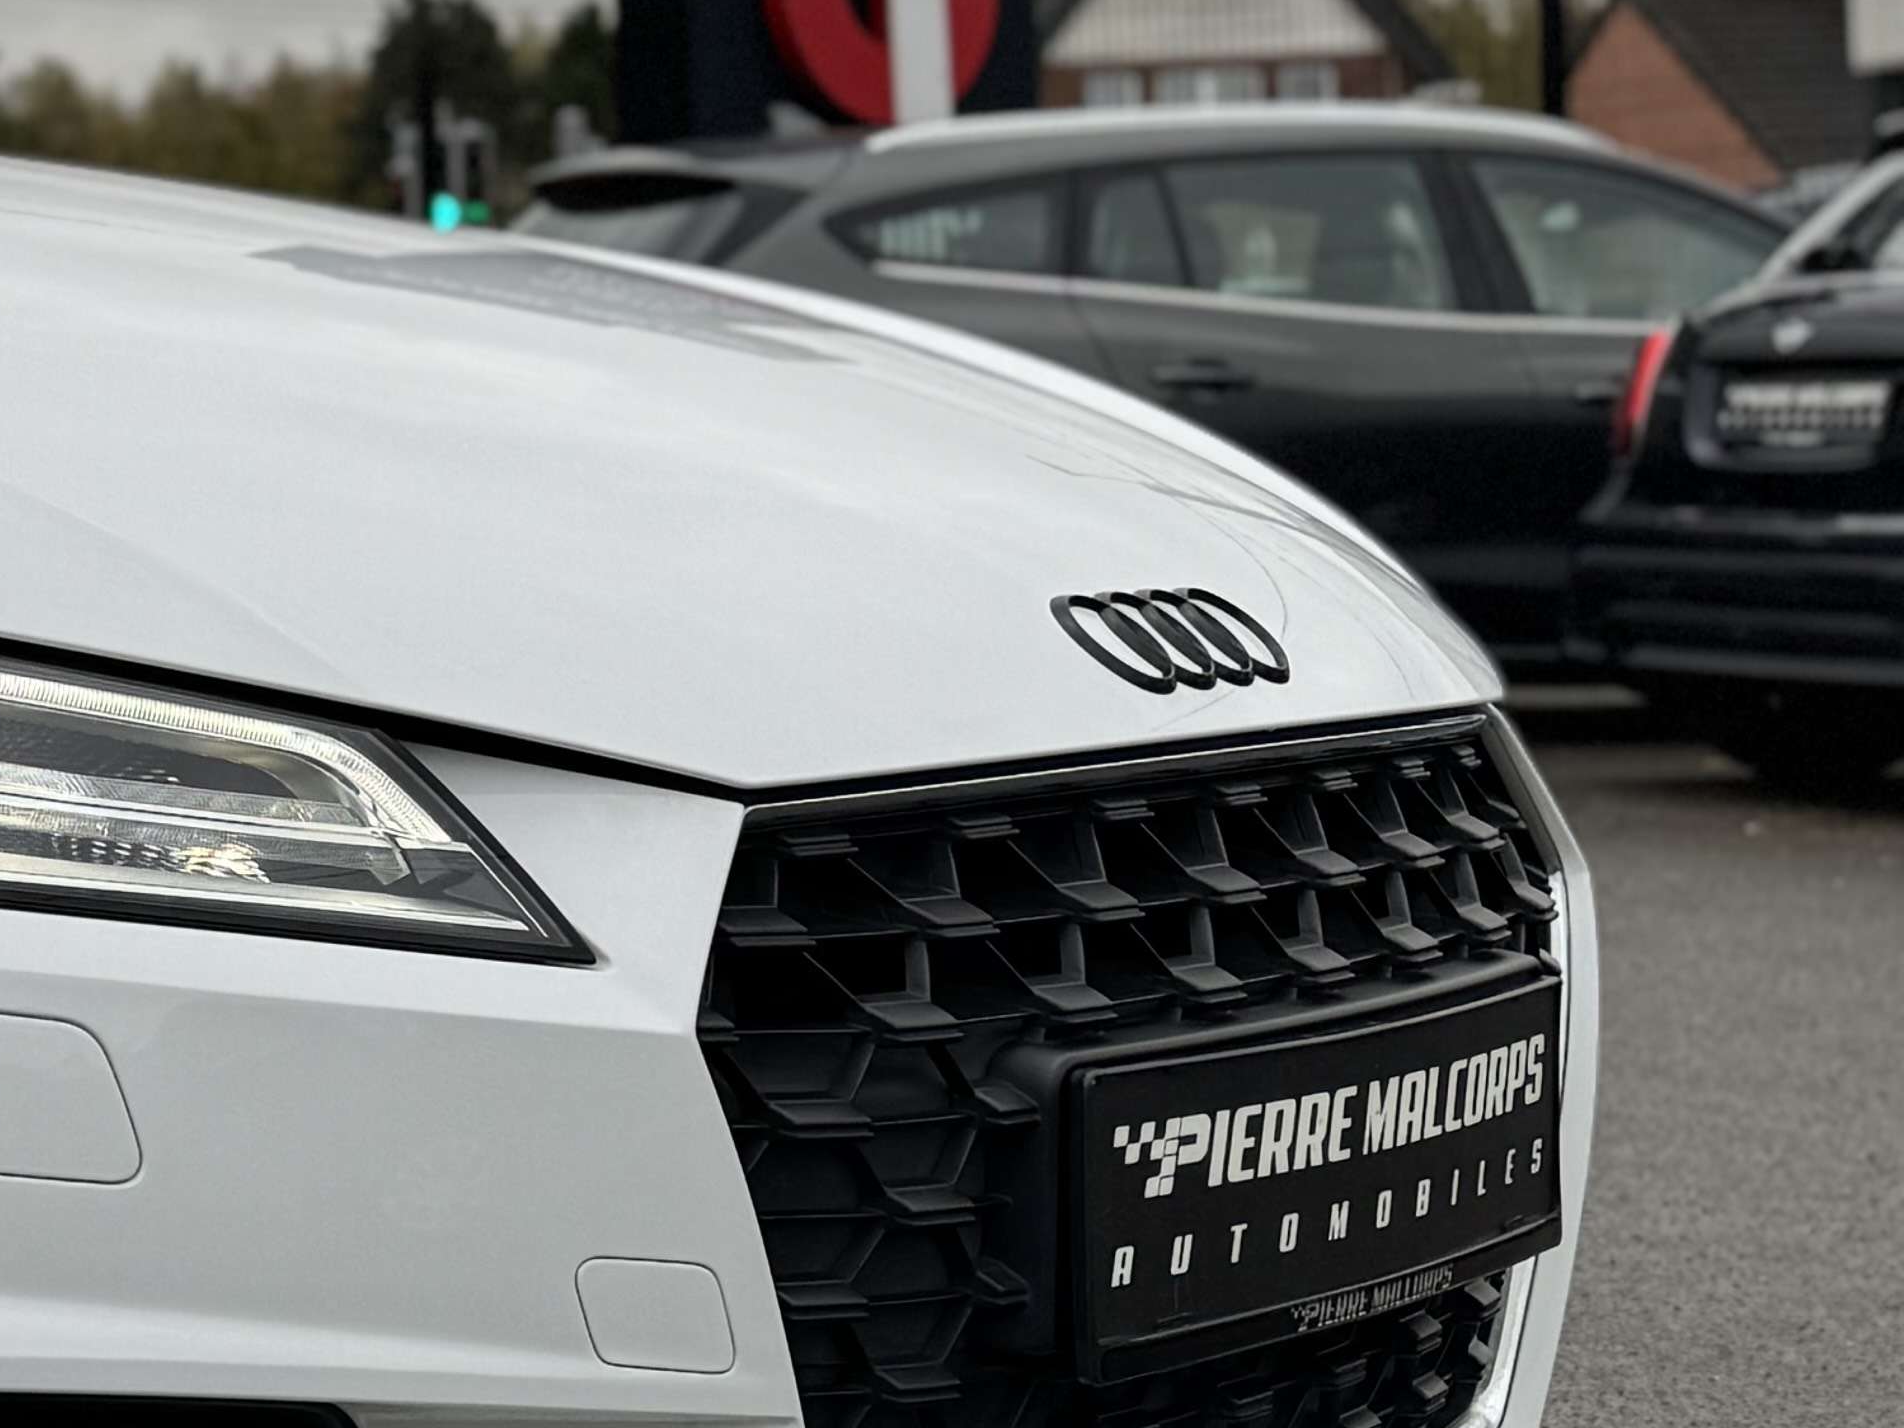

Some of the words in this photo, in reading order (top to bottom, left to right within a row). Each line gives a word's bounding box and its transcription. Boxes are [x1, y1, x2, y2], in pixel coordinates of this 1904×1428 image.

[1144, 1085, 1359, 1199] PIERRE
[1362, 1033, 1546, 1156] MALCORPS
[1110, 1137, 1543, 1288] AUTOMOBILES
